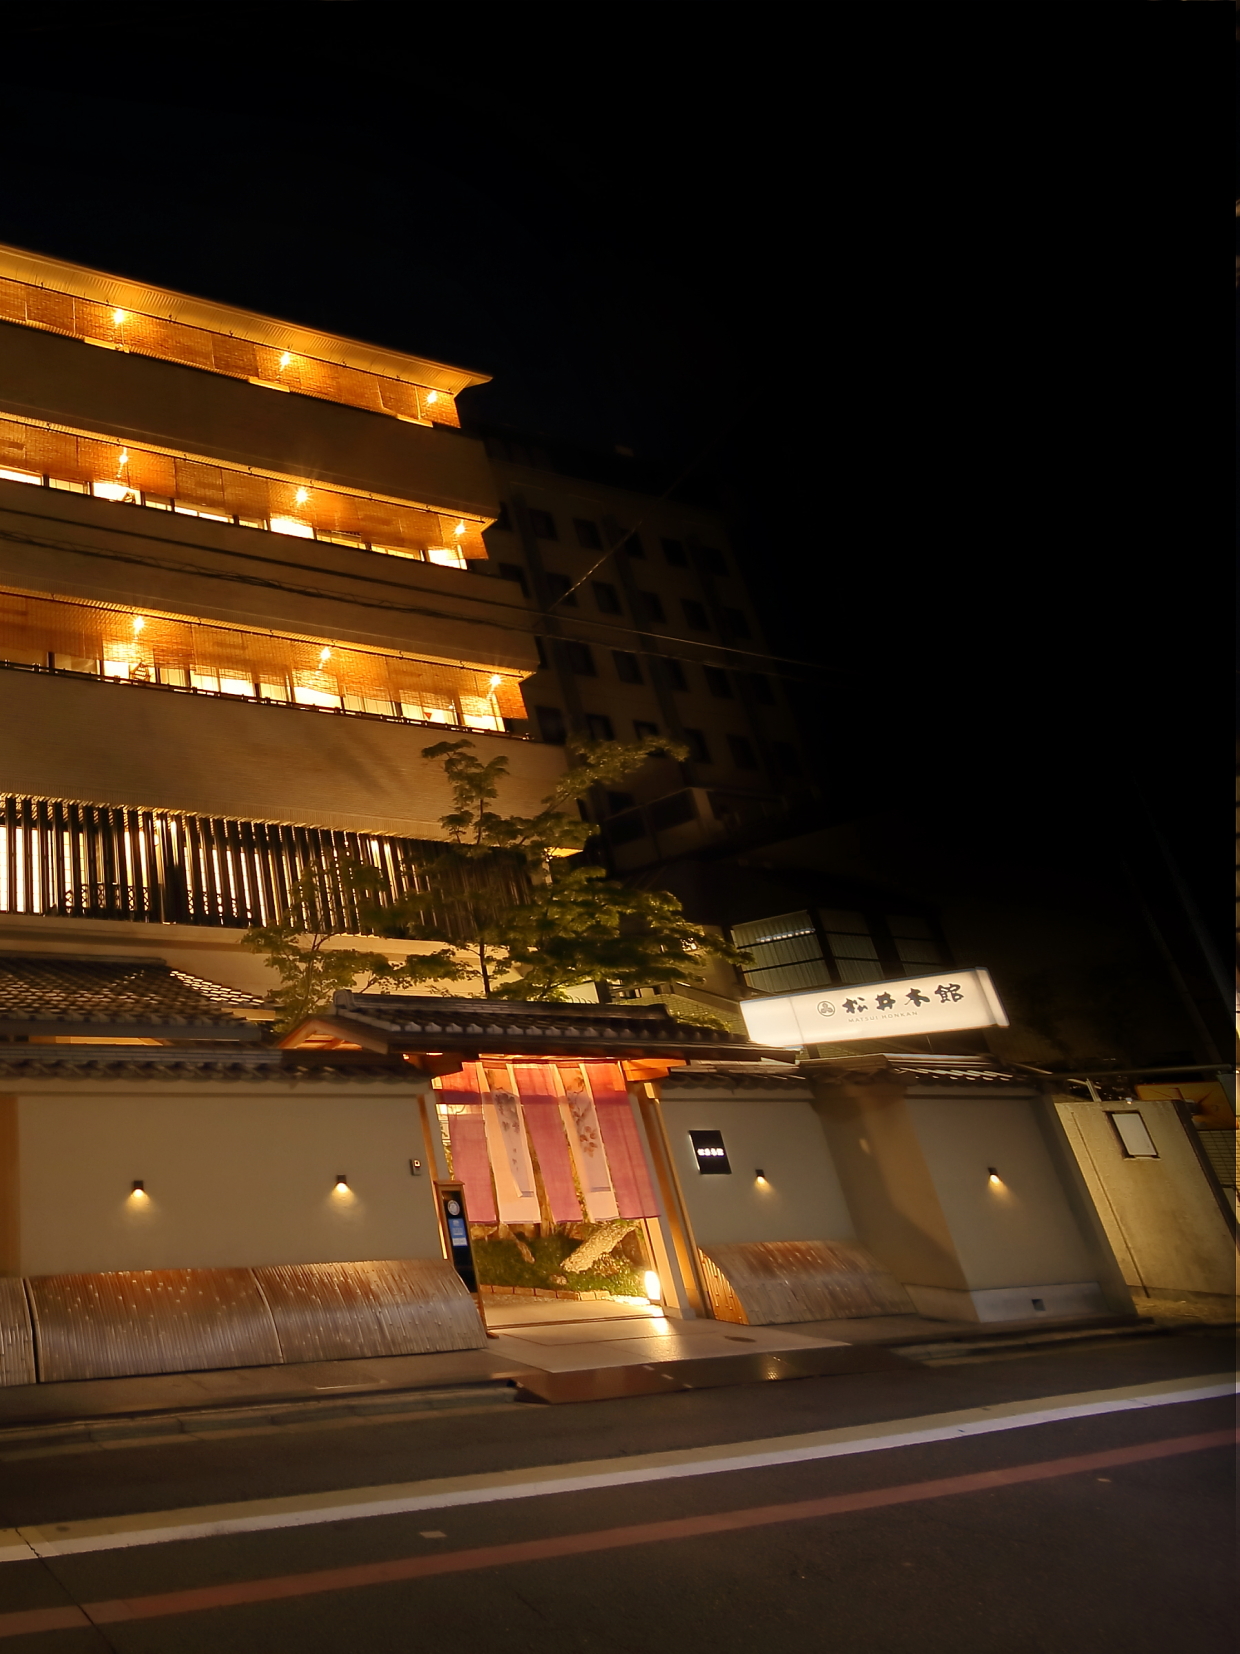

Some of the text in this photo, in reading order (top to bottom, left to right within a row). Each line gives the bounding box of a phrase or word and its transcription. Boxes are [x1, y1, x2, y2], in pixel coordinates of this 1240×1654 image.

[842, 983, 964, 1014] 松井本館
[848, 1011, 918, 1023] MATSUI HONKAN
